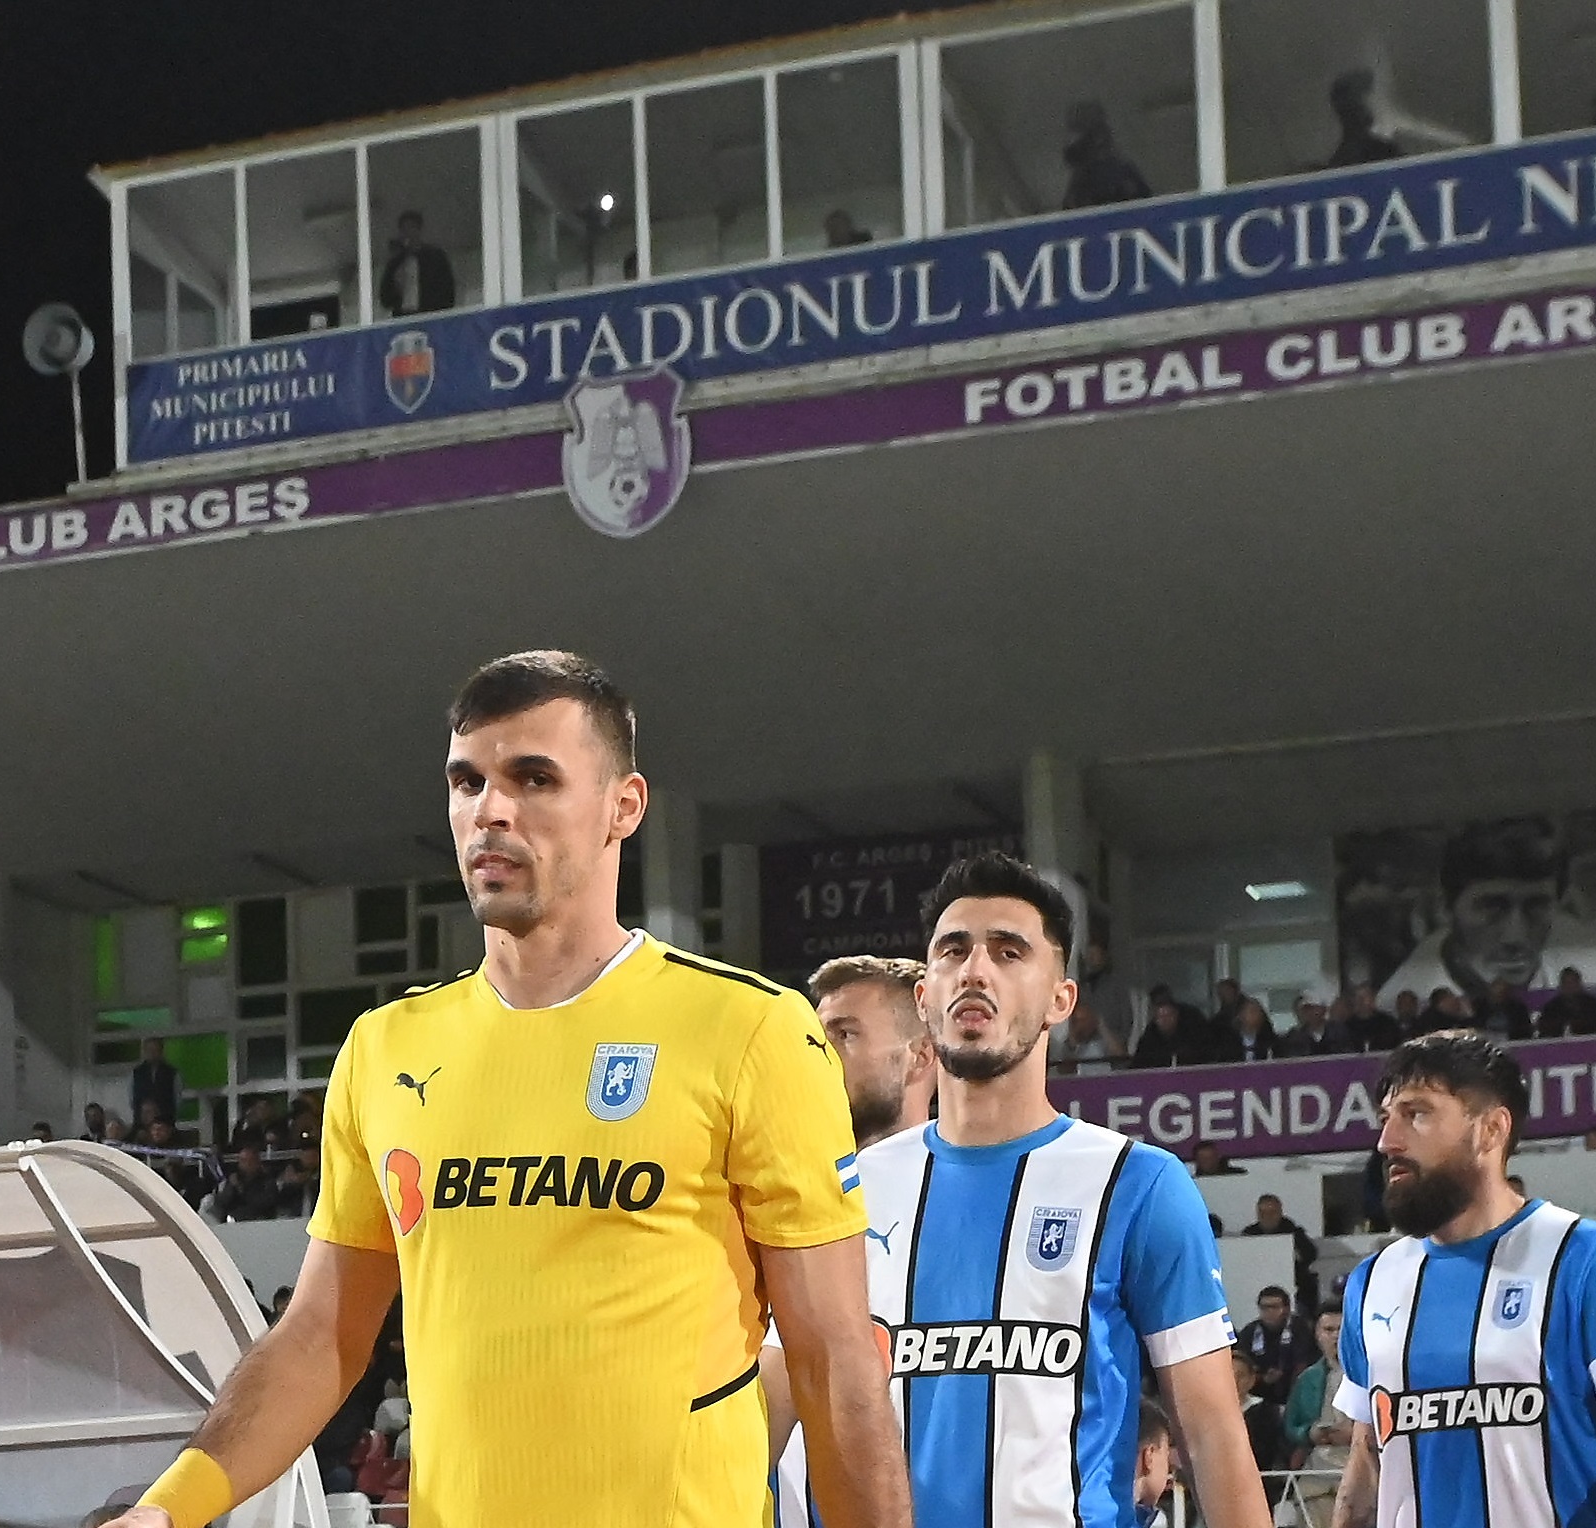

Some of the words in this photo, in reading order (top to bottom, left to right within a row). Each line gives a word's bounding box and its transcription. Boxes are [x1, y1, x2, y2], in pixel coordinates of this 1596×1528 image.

[489, 263, 963, 392] STADIONUL
[981, 176, 1488, 319] MUNICIPAL
[964, 343, 1242, 425] FOTBAL
[1265, 313, 1467, 383] CLUB
[150, 373, 336, 422] MUNICIPIULUI
[795, 876, 896, 920] 1971
[802, 929, 927, 955] CAMPIOAN
[597, 1045, 654, 1055] CRAIOVA
[433, 1155, 665, 1212] BETANO
[893, 1326, 1083, 1374] BETANO
[1396, 1386, 1545, 1432] BETANO
